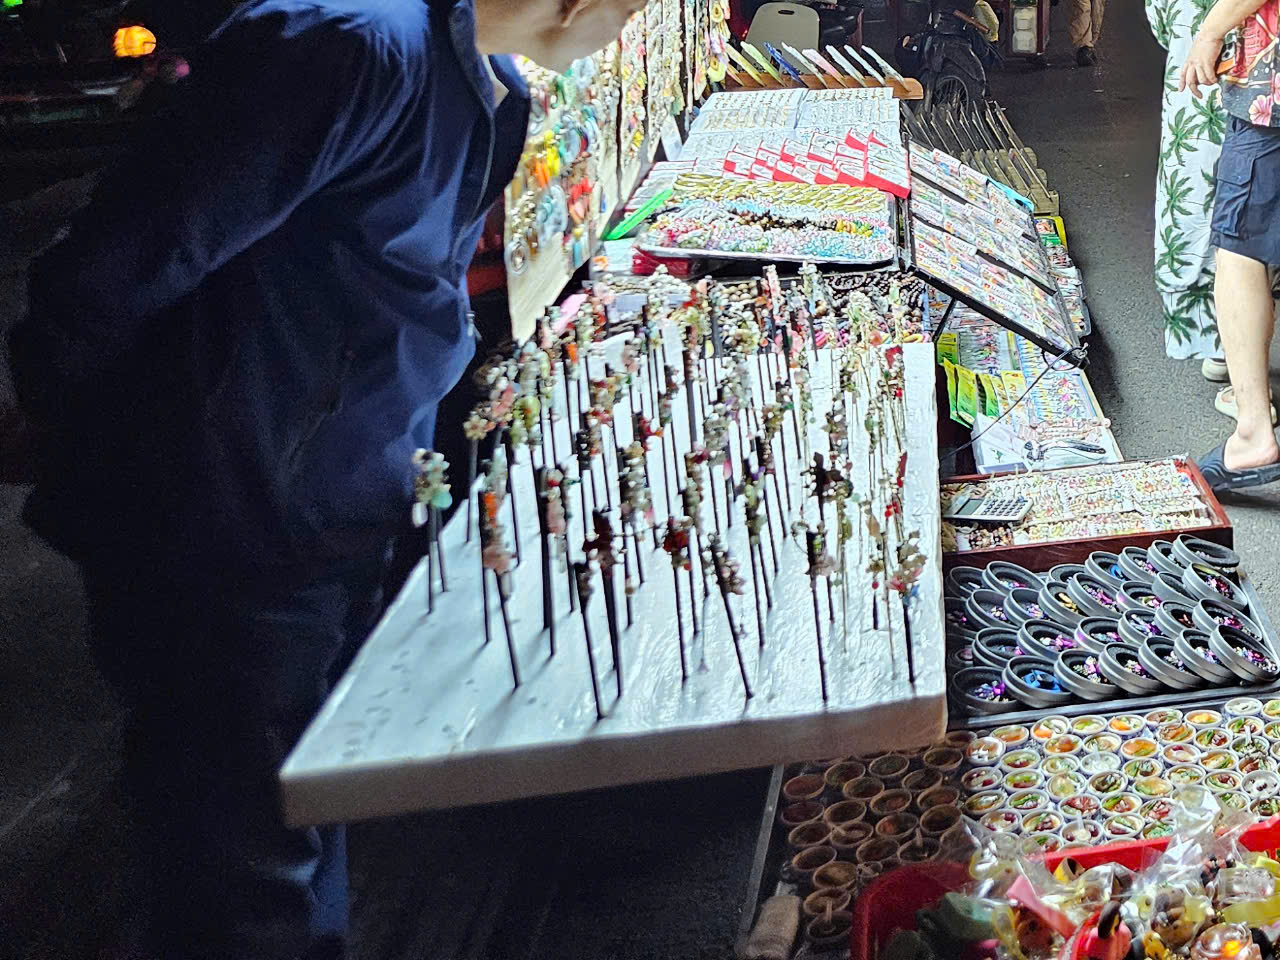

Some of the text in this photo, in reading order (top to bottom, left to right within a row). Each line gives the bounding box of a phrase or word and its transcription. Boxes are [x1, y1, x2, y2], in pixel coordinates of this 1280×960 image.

[1000, 219, 1022, 235] MAGNET
[950, 237, 974, 253] MAGNET
[922, 246, 947, 263] MAGNET
